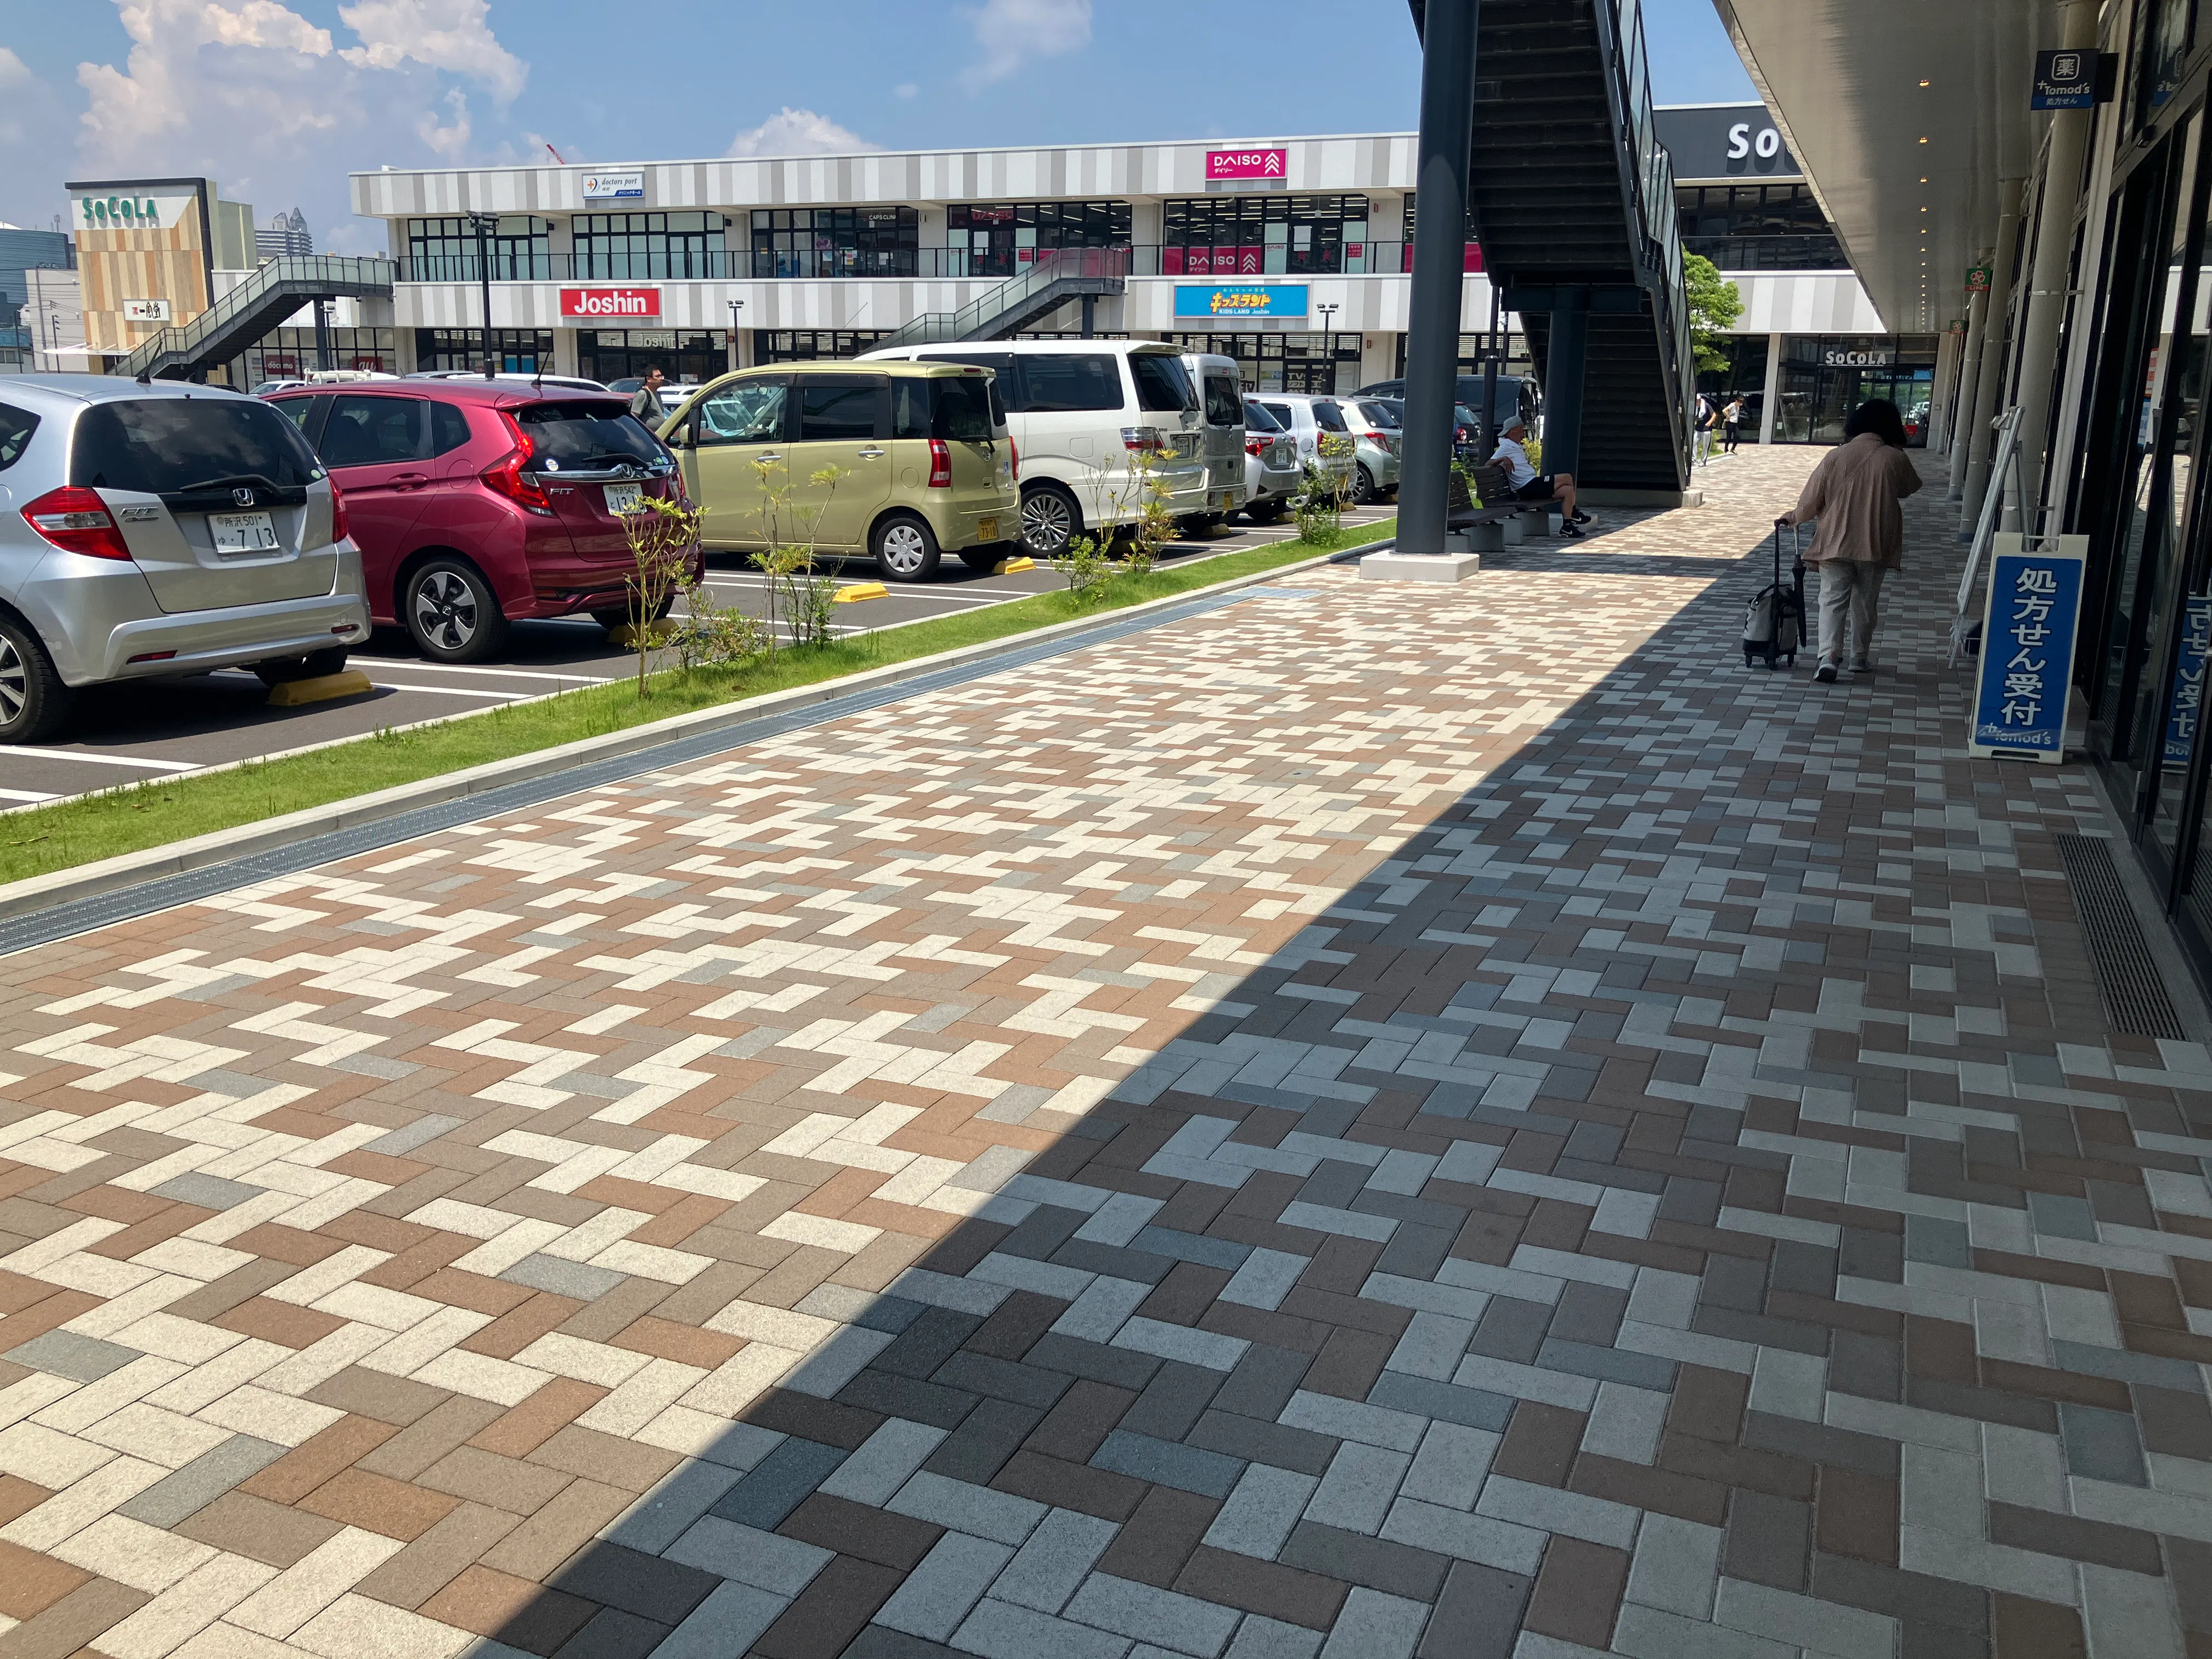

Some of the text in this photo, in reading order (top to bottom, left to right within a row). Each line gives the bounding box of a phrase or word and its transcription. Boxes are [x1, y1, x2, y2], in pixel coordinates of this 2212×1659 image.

[2056, 58, 2075, 76] 薬
[2044, 82, 2090, 95] Tomod's
[2046, 98, 2078, 106] 処方せん
[1727, 123, 1791, 159] So
[1214, 155, 1261, 166] DAISO
[624, 178, 637, 187] port
[1189, 256, 1235, 265] DAISO
[574, 291, 646, 314] Joshin
[1210, 292, 1272, 314] キッズランド
[637, 332, 676, 348] Joshin
[244, 516, 258, 526] 501
[2001, 568, 2057, 726] 処方せん受付
